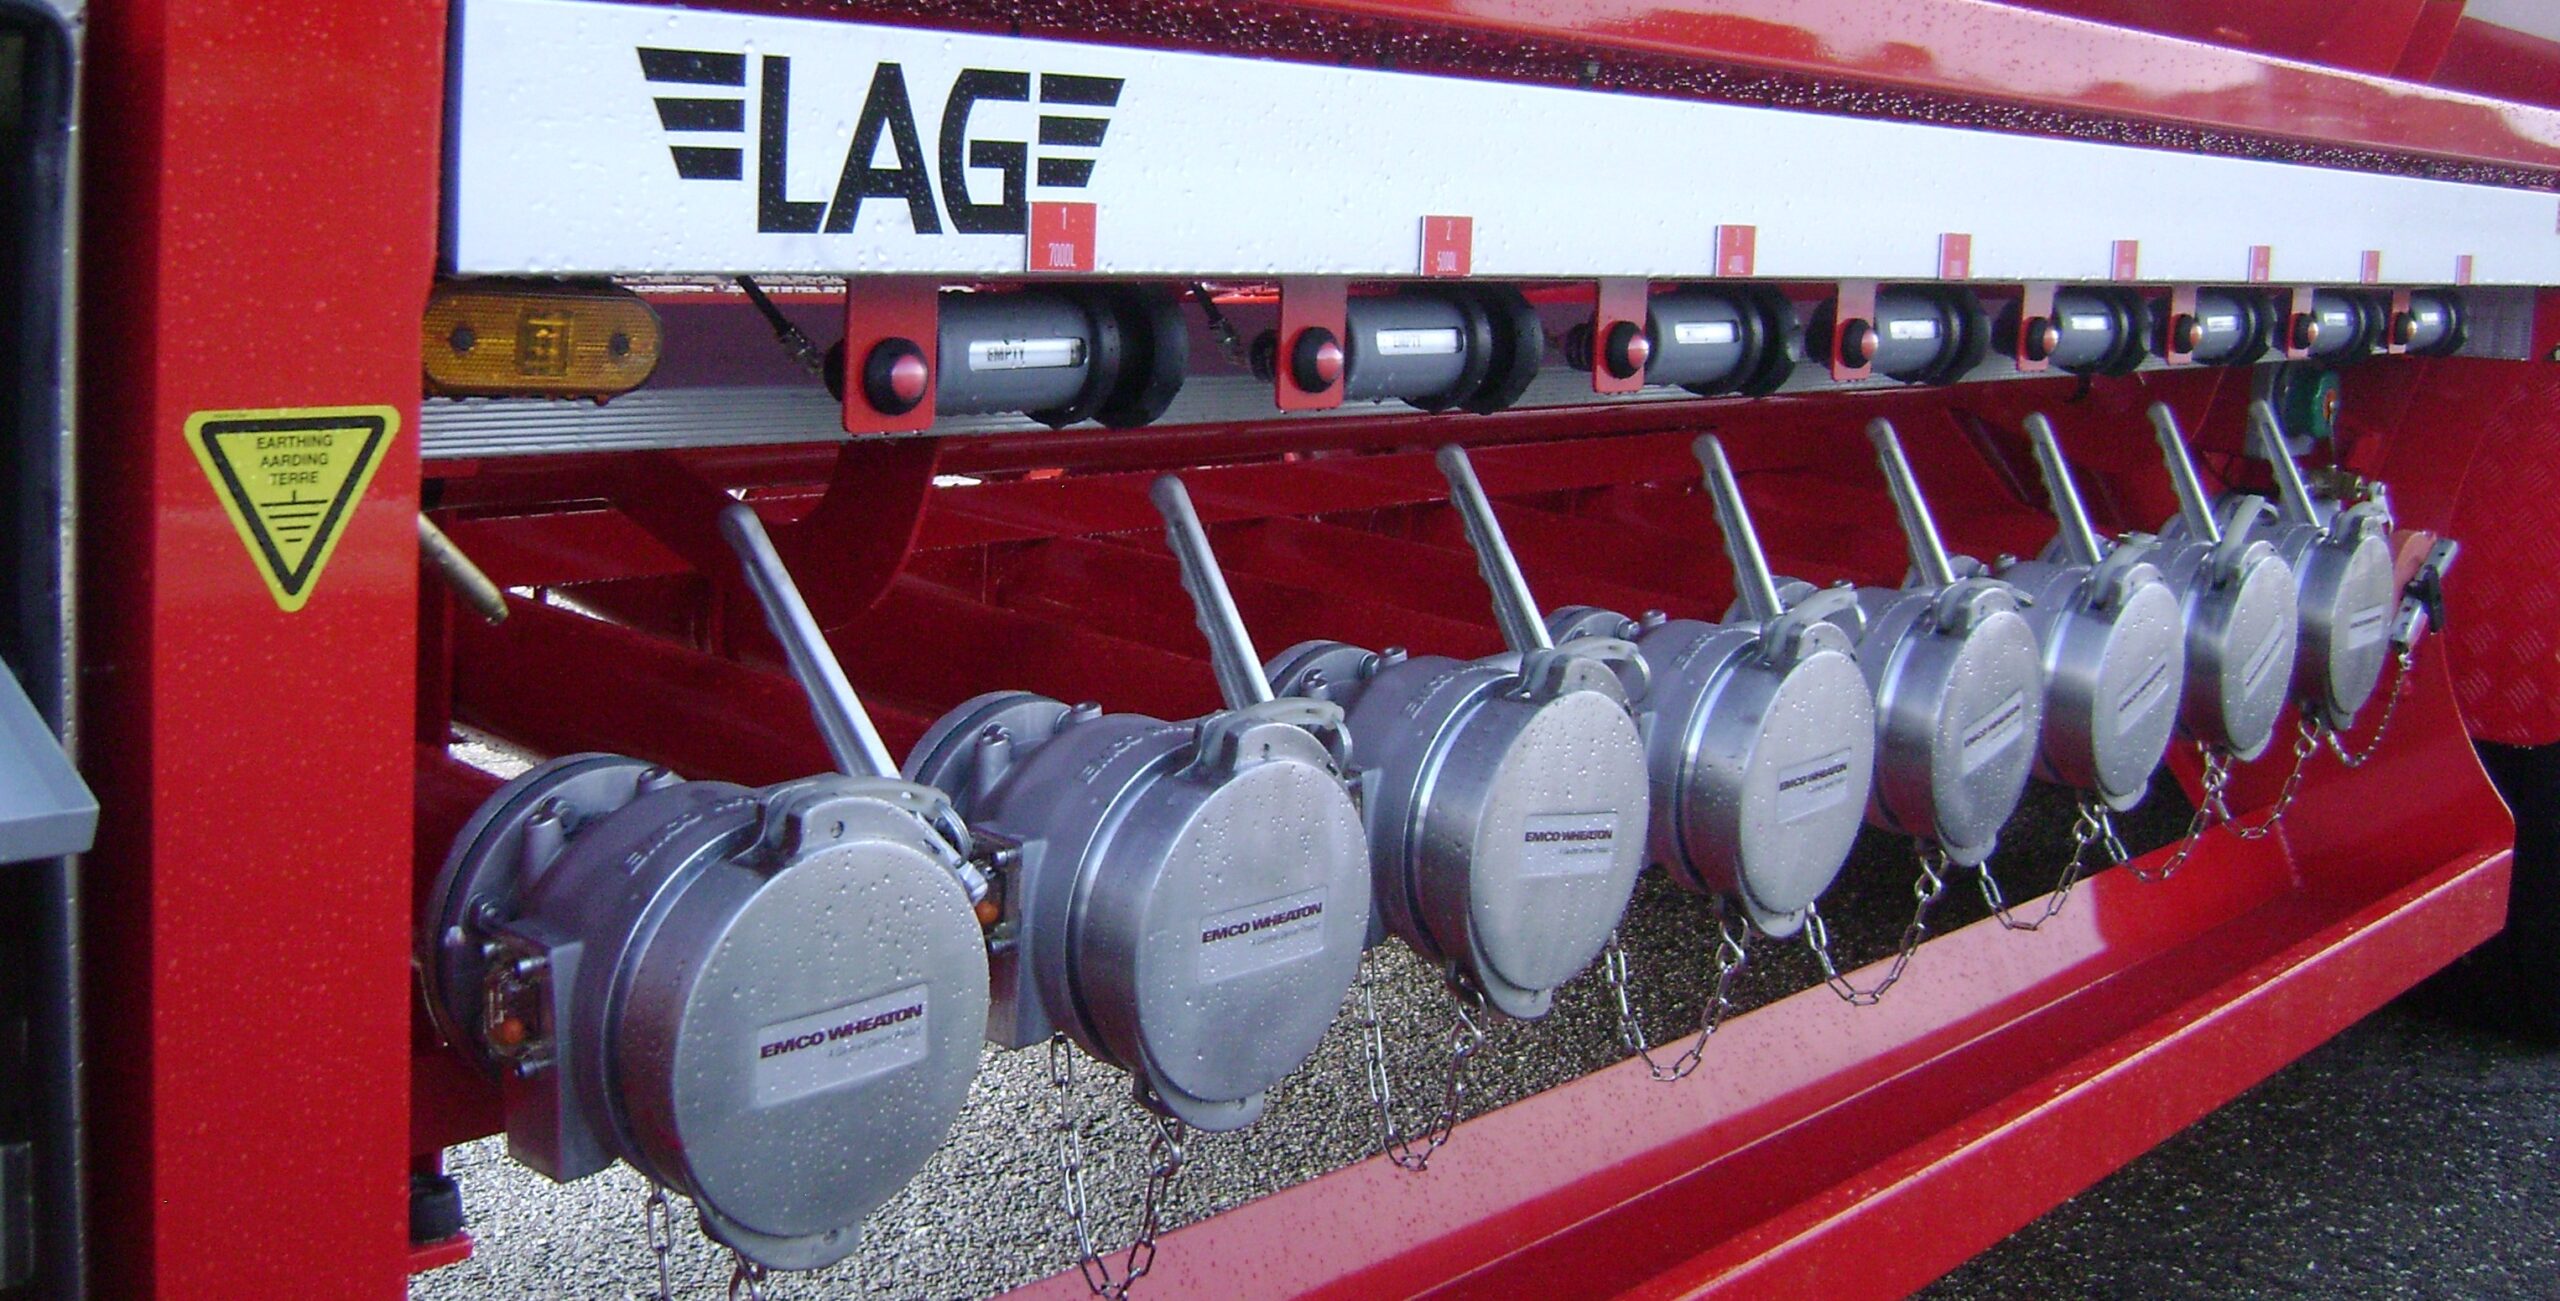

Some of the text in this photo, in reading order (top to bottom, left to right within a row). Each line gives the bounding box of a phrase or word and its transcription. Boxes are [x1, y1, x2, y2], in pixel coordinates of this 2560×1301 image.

[757, 54, 1030, 234] LAG
[1048, 243, 1077, 267] 7000L
[256, 434, 333, 449] EARTHING
[260, 453, 329, 468] AARDING
[270, 471, 319, 486] TERRE
[1525, 831, 1560, 842] EMCO
[1202, 922, 1250, 944] EMCO
[1252, 902, 1322, 931] WHEATON
[760, 1031, 825, 1059] EMCO
[828, 1004, 923, 1040] WHEATON
